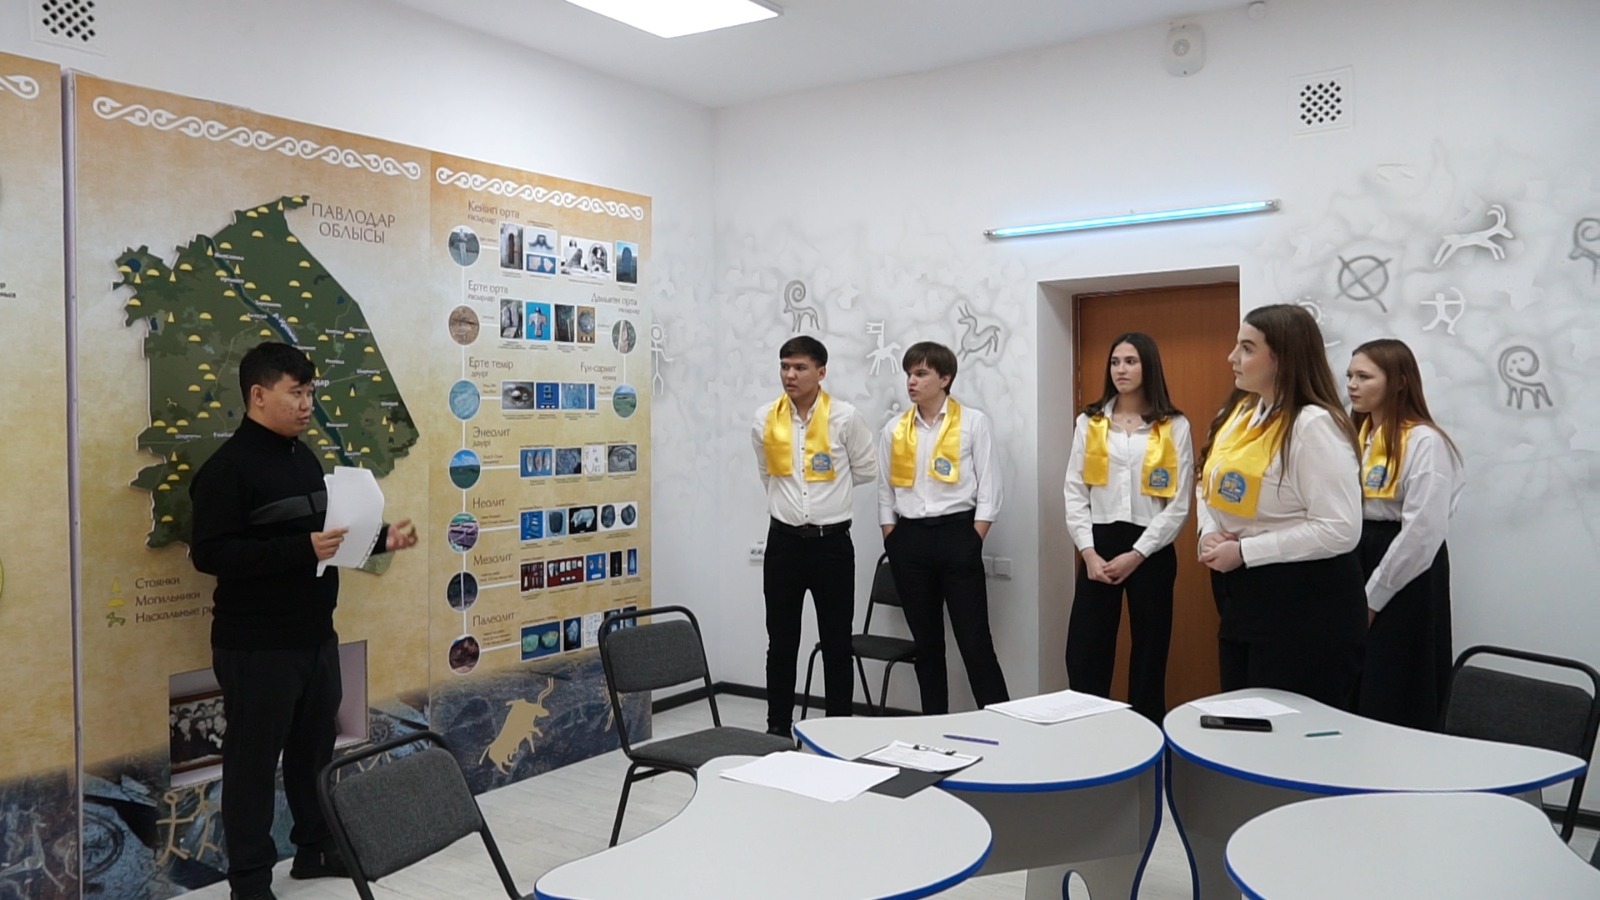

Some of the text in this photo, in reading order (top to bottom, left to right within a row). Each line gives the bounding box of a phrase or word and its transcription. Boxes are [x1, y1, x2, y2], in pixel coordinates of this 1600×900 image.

[311, 202, 395, 228] ПАВЛОДАР
[499, 208, 519, 219] орта
[319, 221, 385, 244] ОБЛЫСЫ
[468, 280, 508, 295] Ерте орта
[468, 357, 514, 370] Ерте темір
[472, 426, 511, 438] Энеолит
[472, 497, 506, 509] Неолит
[473, 553, 513, 566] Мезолит
[135, 577, 180, 589] Стоянки
[135, 591, 201, 607] Могильники
[135, 607, 200, 623] Наскальные
[472, 612, 516, 627] Палеолит
